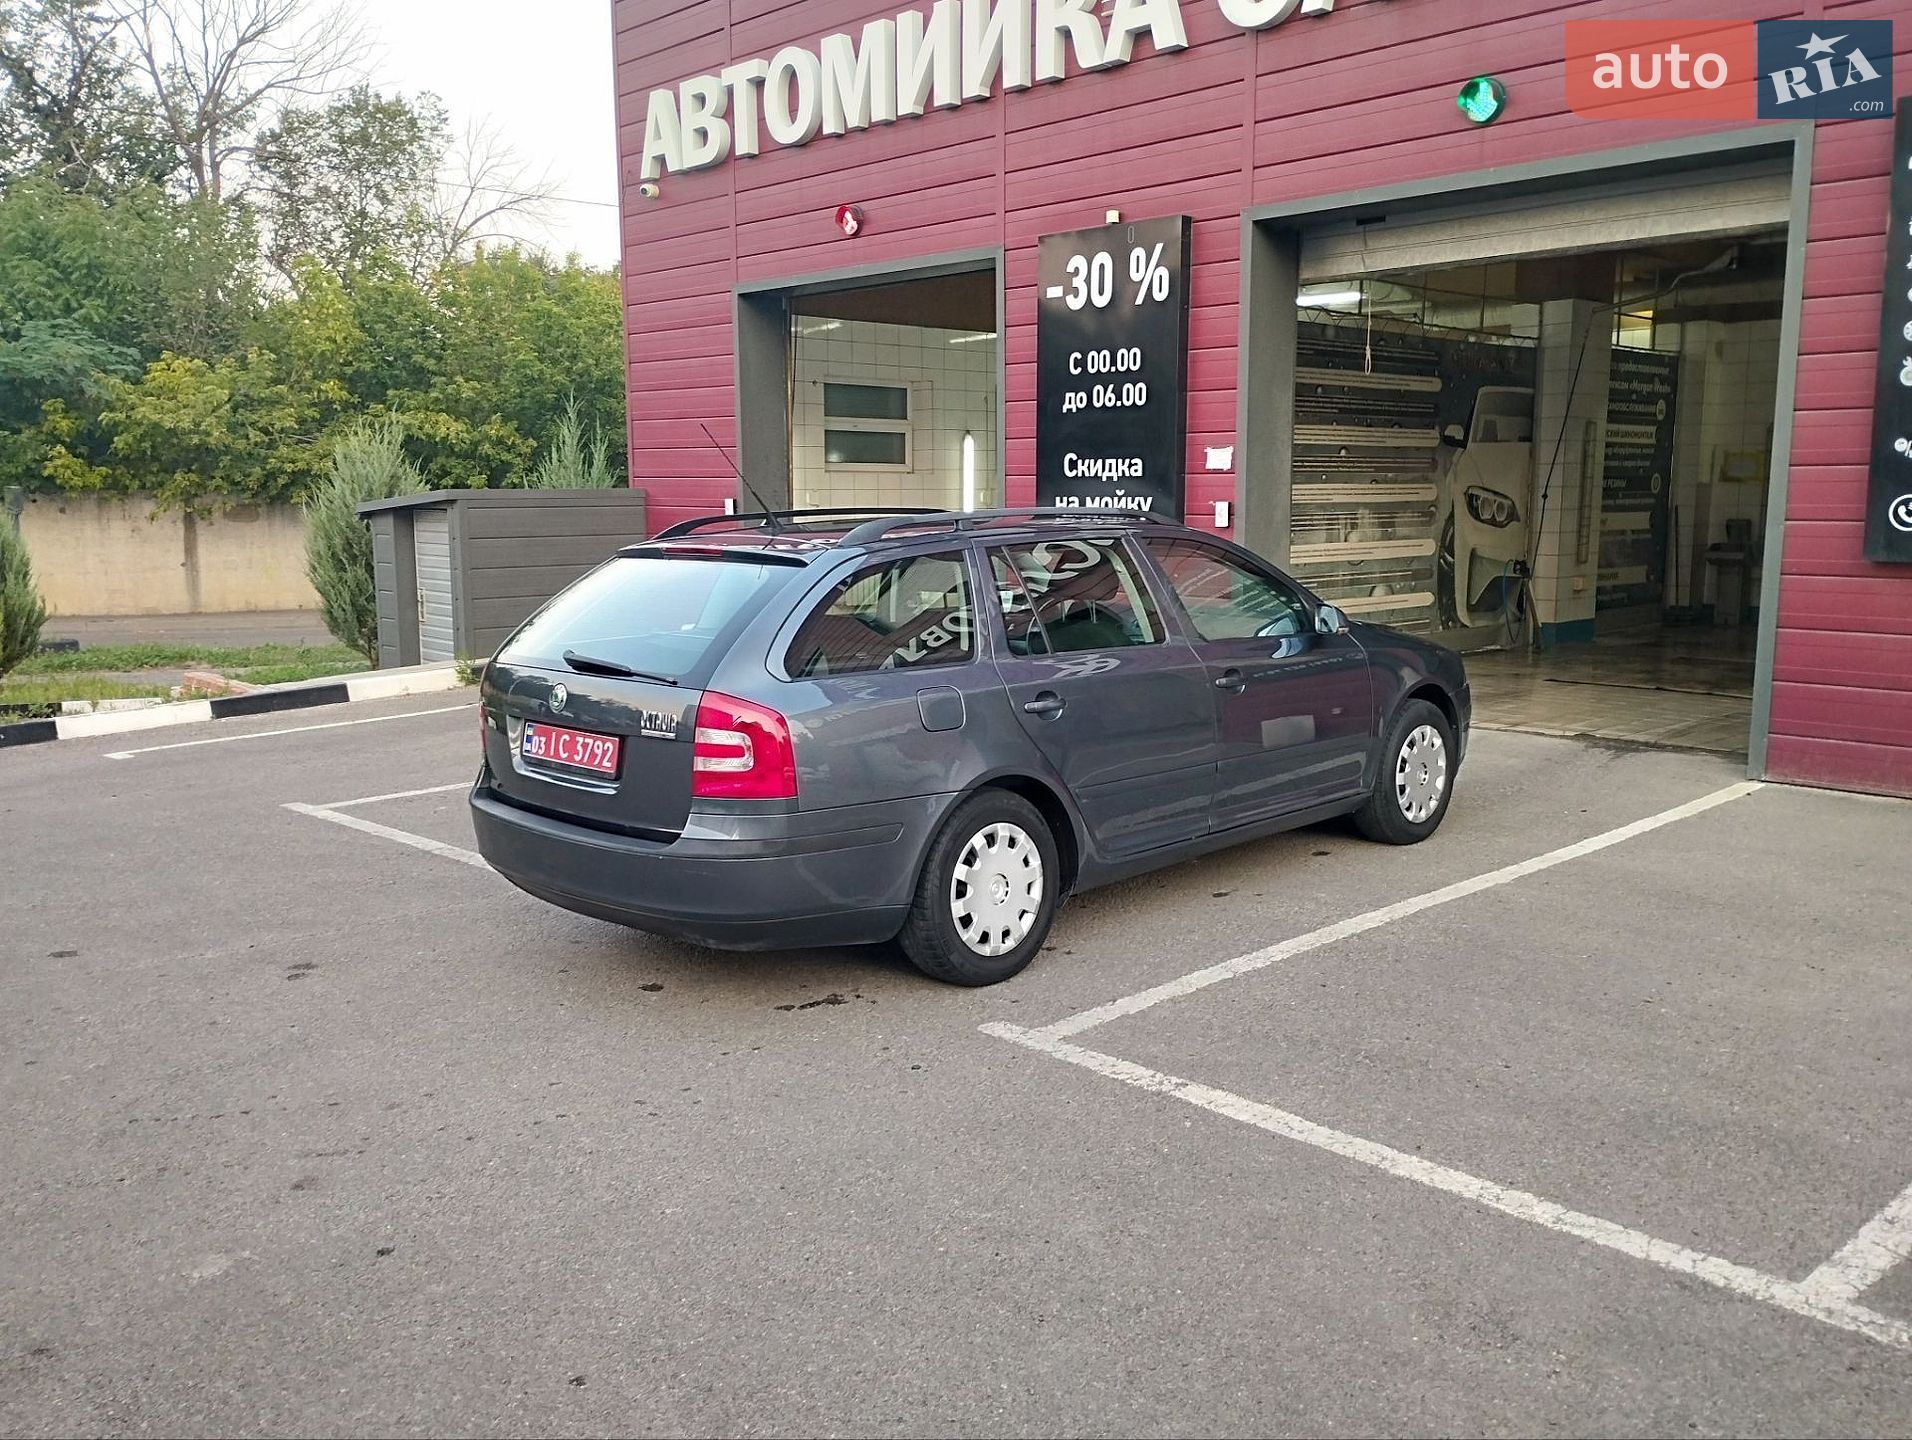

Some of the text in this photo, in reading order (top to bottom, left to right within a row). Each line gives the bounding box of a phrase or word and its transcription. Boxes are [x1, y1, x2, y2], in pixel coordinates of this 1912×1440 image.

[1046, 242, 1171, 311] -30 %
[1087, 347, 1141, 374] 00.00
[1062, 382, 1147, 413] до 06.00
[1063, 453, 1144, 481] Скидка
[573, 736, 614, 768] 3792
